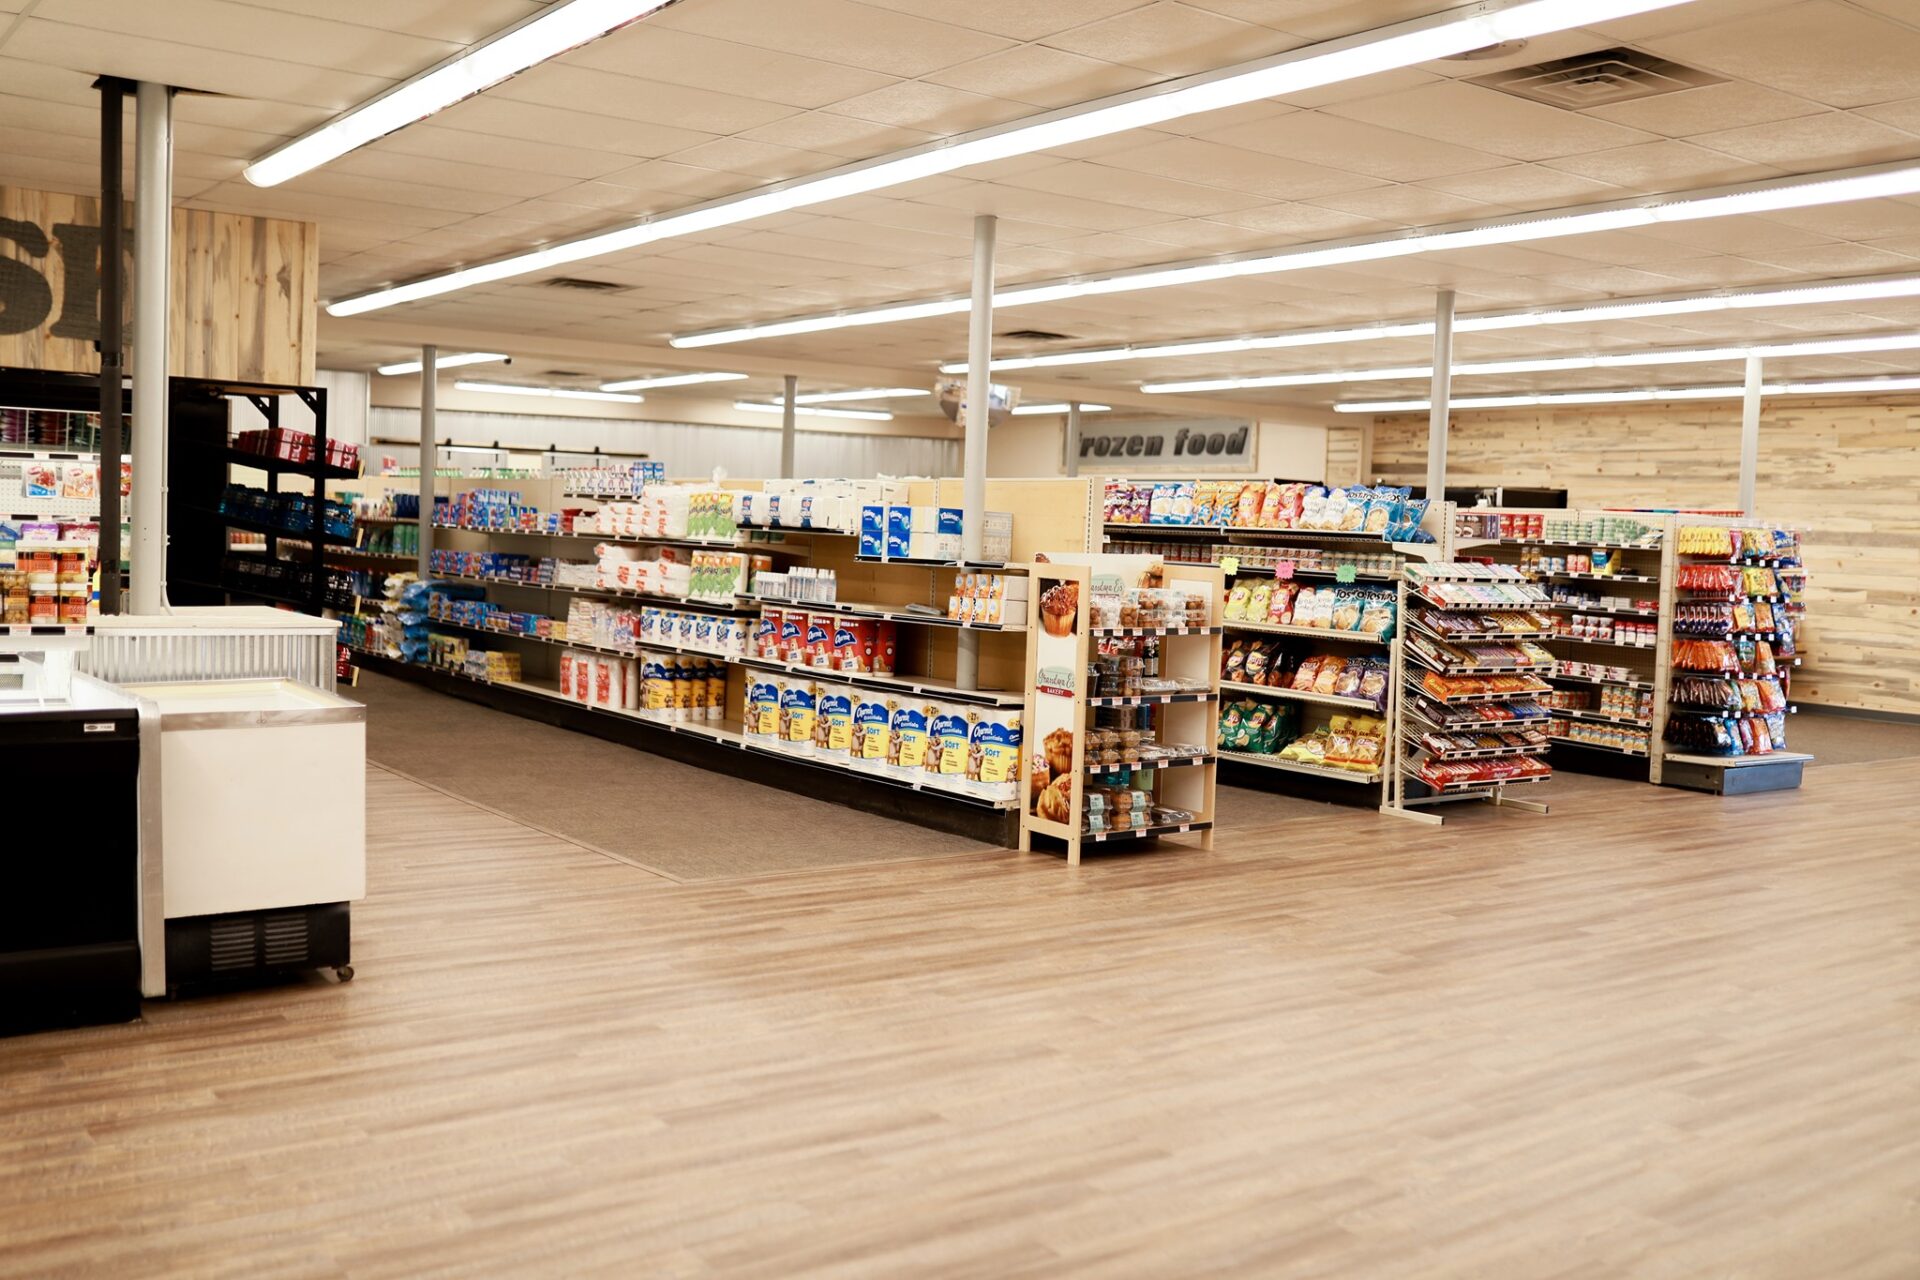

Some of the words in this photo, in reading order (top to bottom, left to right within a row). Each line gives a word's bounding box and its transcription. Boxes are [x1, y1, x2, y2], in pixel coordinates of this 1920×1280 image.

[1079, 432, 1164, 457] rozen
[1173, 425, 1249, 456] food
[831, 718, 845, 727] SOFT
[866, 726, 880, 735] SOFT
[903, 733, 916, 743] SOFT
[944, 739, 960, 750] SOFT
[984, 747, 1001, 758] SOFT
